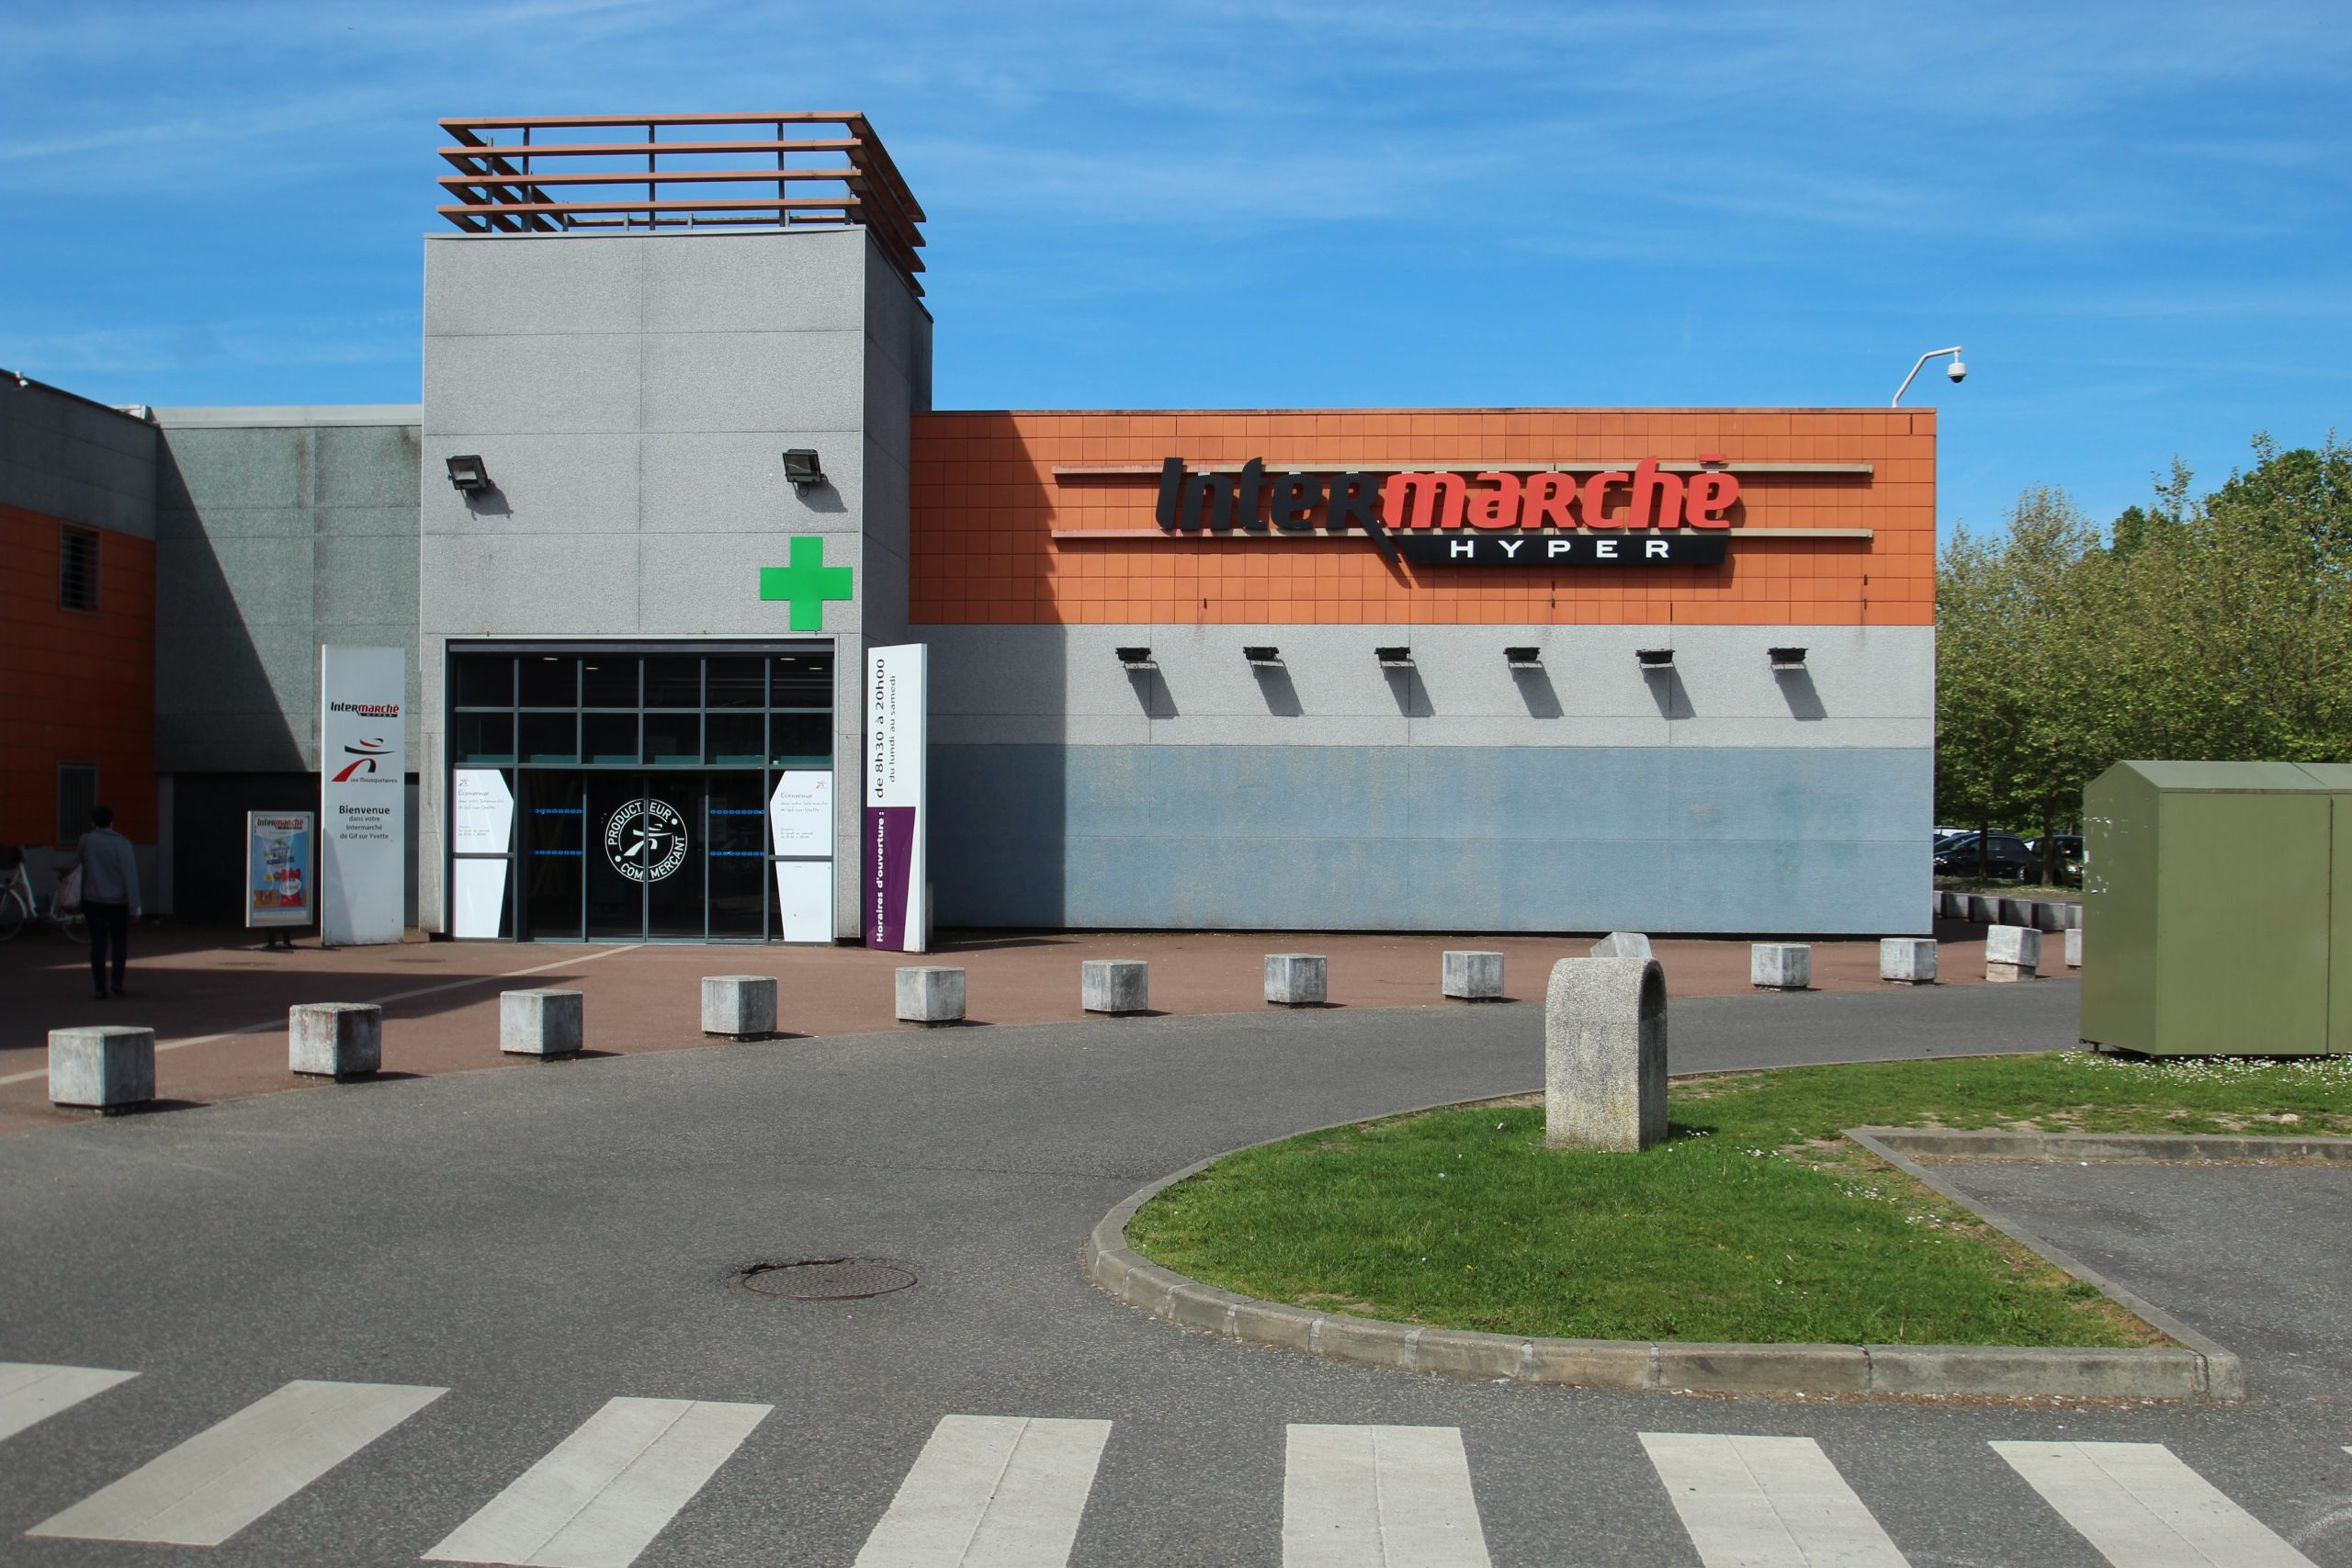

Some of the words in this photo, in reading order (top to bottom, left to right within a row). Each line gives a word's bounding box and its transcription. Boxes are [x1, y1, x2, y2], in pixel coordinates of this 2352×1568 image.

[1450, 540, 1670, 558] HYPER
[876, 659, 885, 710] 20h00
[876, 716, 884, 725] à
[889, 718, 896, 732] au
[875, 731, 884, 773] 8h30
[888, 768, 895, 783] du
[875, 778, 883, 798] de
[338, 805, 390, 815] Bienvenue
[876, 818, 885, 888] d'ouverture
[876, 892, 884, 942] Horaires
